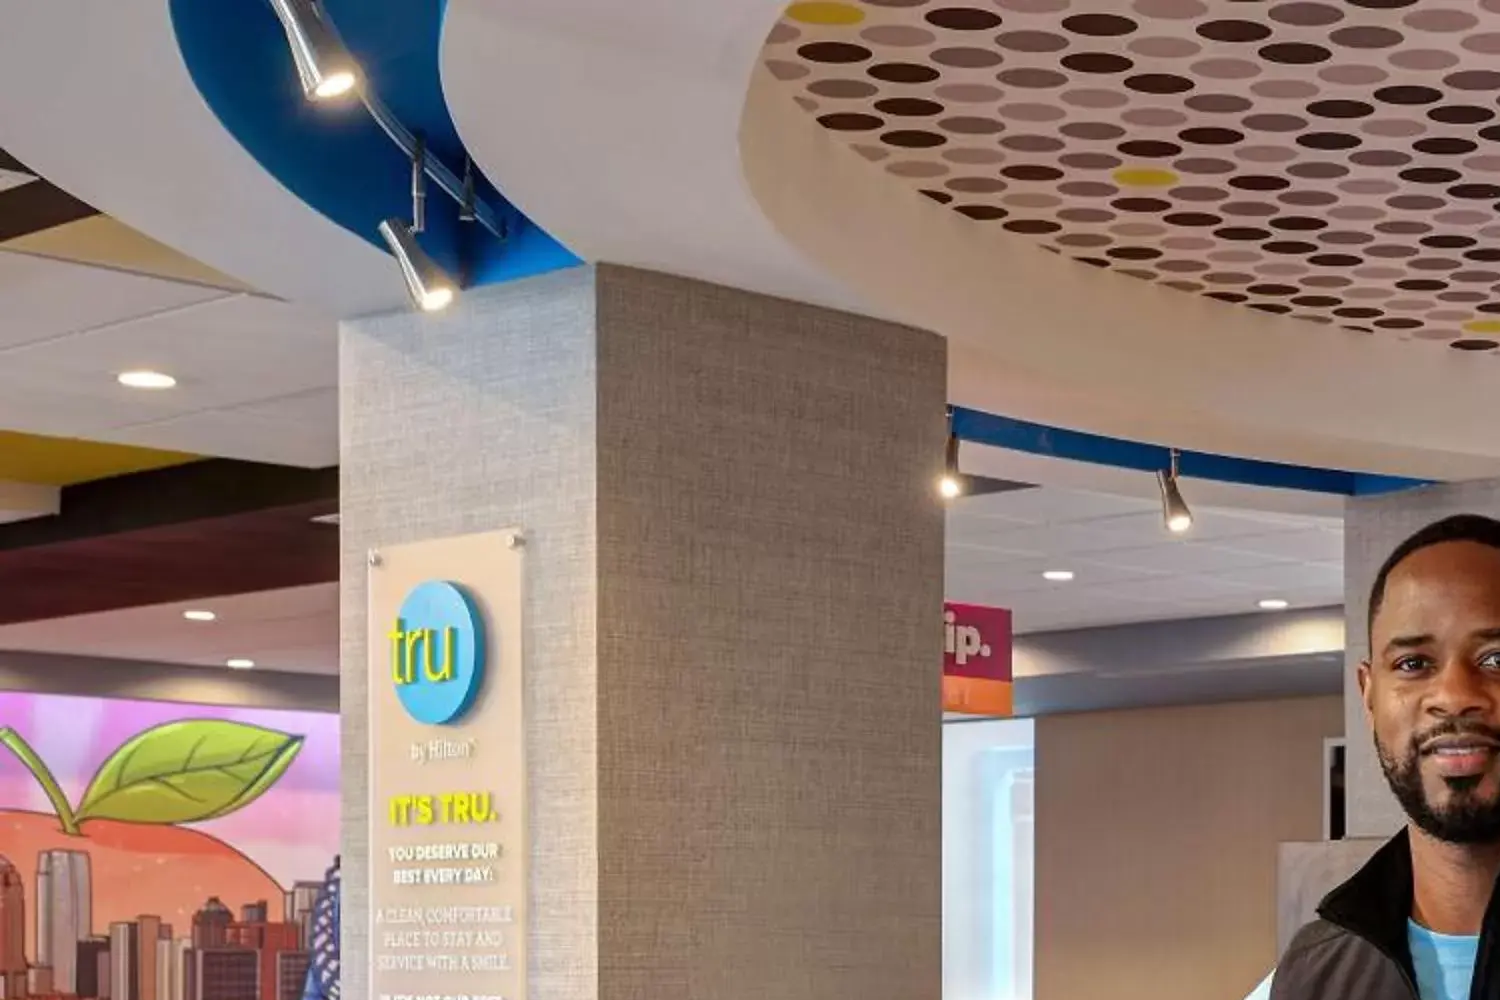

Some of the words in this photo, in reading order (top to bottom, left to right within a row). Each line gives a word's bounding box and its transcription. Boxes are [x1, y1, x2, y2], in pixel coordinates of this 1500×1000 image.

[387, 617, 455, 683] tru
[411, 743, 426, 765] by
[428, 738, 469, 759] Hilton
[389, 794, 433, 827] IT'S
[438, 791, 498, 824] TRU.
[388, 847, 413, 863] YOU
[416, 844, 469, 860] DESERVE
[472, 843, 498, 859] OUR
[393, 869, 421, 884] BEST
[424, 868, 463, 884] EVERY
[425, 931, 439, 947] TO
[442, 931, 472, 948] STAY
